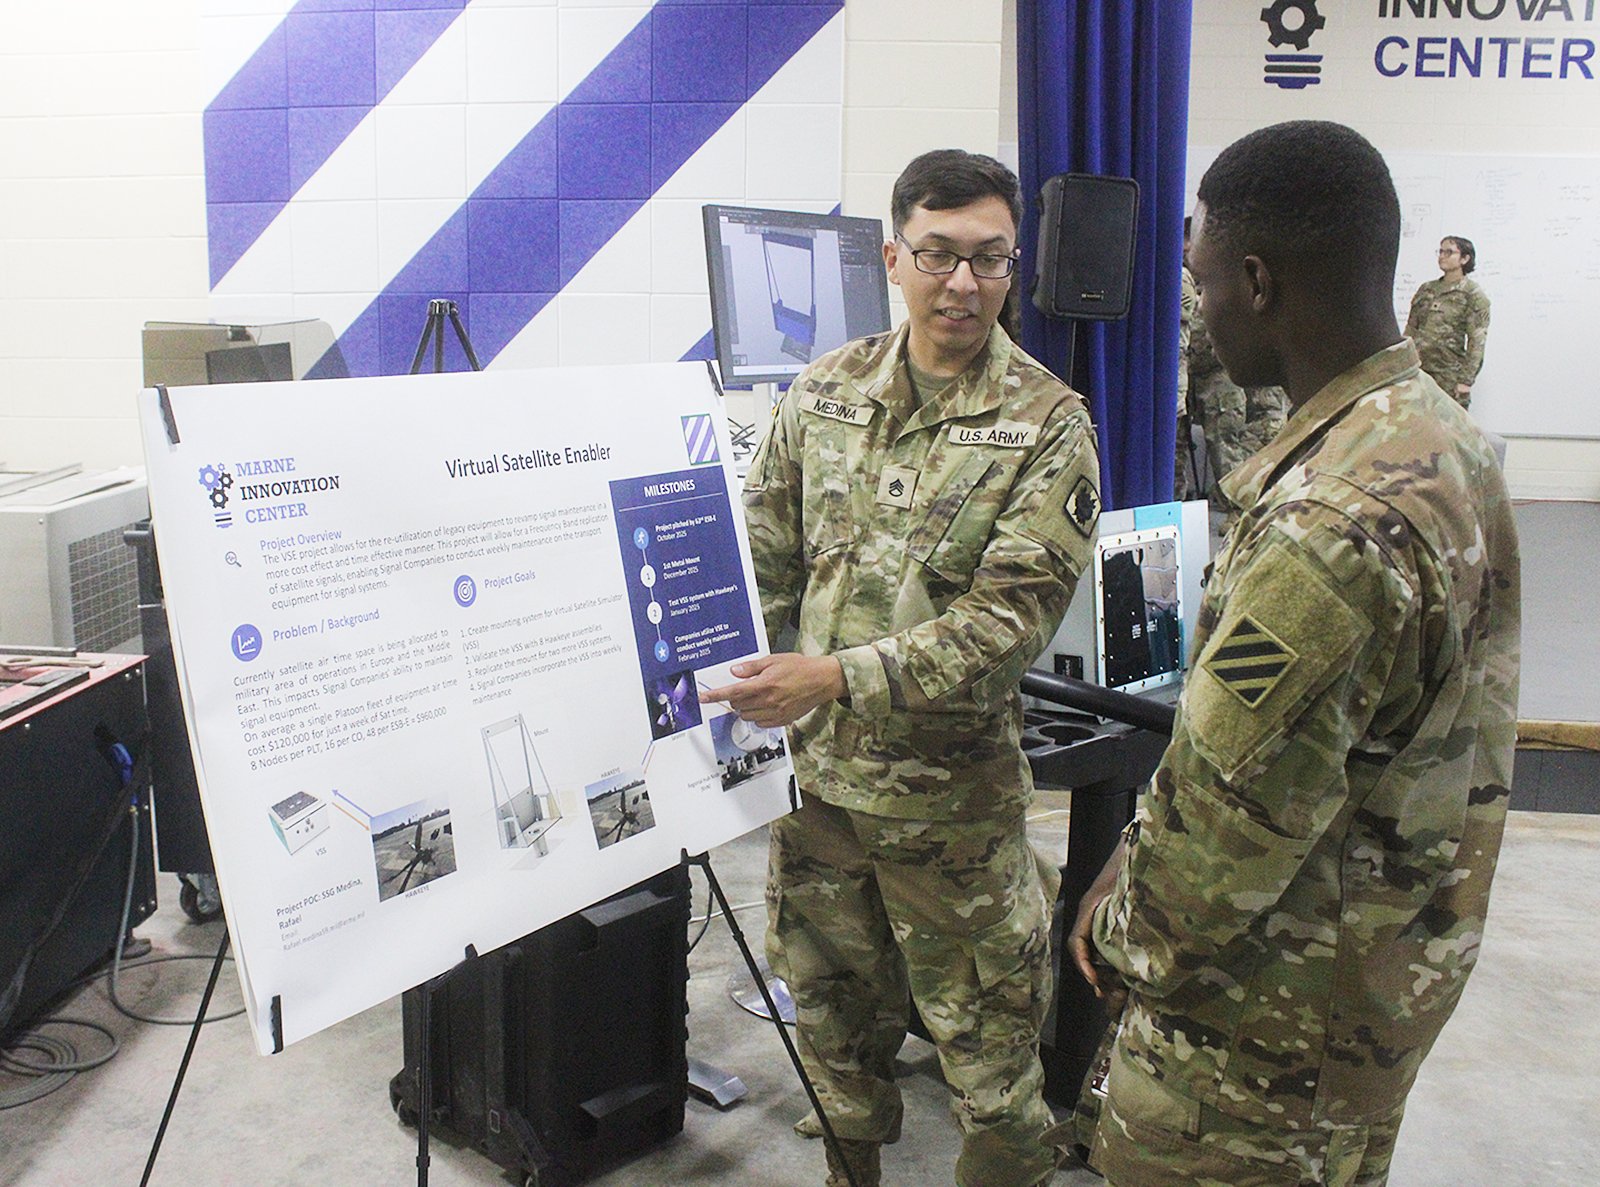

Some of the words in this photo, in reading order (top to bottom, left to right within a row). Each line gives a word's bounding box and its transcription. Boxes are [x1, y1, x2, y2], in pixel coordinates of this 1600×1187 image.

[1374, 35, 1596, 79] CENTER
[813, 398, 857, 421] MEDINA
[959, 429, 983, 442] U.S.
[987, 429, 1029, 446] ARMY
[235, 457, 295, 476] MARNE
[445, 454, 499, 478] Virtual
[502, 449, 561, 471] Satellite
[564, 443, 610, 464] Enabler
[240, 475, 339, 500] INNOVATION
[644, 479, 695, 497] MILESTONES
[245, 502, 308, 523] CENTER
[260, 536, 295, 551] Project
[297, 529, 341, 544] Overview
[262, 554, 279, 564] The
[280, 549, 297, 561] VSE
[299, 546, 328, 560] project
[329, 542, 354, 554] allows
[355, 539, 366, 549] for
[368, 537, 381, 547] the
[383, 529, 432, 544] re-utilization
[442, 525, 465, 536] legacy
[467, 518, 504, 532] equipment
[538, 508, 557, 521] signal
[557, 504, 596, 516] maintenance
[266, 568, 289, 579] more
[291, 564, 308, 575] cost
[310, 560, 333, 572] effect
[334, 556, 350, 567] and
[350, 554, 368, 564] time
[370, 548, 402, 561] effective
[404, 543, 435, 555] manner.
[437, 539, 452, 549] This
[453, 535, 479, 548] project
[479, 532, 492, 542] will
[494, 530, 512, 540] allow
[513, 527, 523, 536] for
[529, 522, 561, 533] Frequency
[562, 518, 578, 528] Band
[268, 583, 278, 595] of
[280, 578, 314, 592] satellite
[346, 567, 379, 580] enabling
[379, 561, 402, 575] Signal
[403, 555, 445, 569] Companies
[455, 548, 484, 560] conduct
[486, 543, 510, 554] weekly
[511, 536, 552, 550] maintenance
[562, 532, 573, 540] the
[484, 575, 512, 588] Project
[514, 569, 535, 582] Goals
[271, 592, 319, 610] equipment
[320, 590, 332, 599] for
[334, 584, 356, 598] signal
[358, 580, 389, 593] systems.
[273, 624, 317, 641] Problem
[327, 608, 379, 629] Background
[233, 669, 274, 686] Currently
[279, 661, 313, 676] satellite
[318, 656, 328, 666] air
[333, 652, 352, 663] time
[355, 647, 375, 659] space
[386, 639, 406, 650] being
[408, 630, 438, 645] allocated
[235, 686, 269, 700] military
[274, 680, 294, 691] area
[298, 674, 307, 685] of
[312, 665, 356, 682] operations
[370, 656, 394, 668] Europe
[397, 650, 410, 661] and
[412, 647, 424, 657] the
[427, 640, 450, 652] Middle
[237, 703, 259, 714] East.
[262, 696, 281, 708] This
[284, 688, 319, 703] impacts
[322, 679, 347, 694] Signal
[392, 664, 412, 676] ability
[240, 713, 267, 729] signal
[269, 702, 320, 721] equipment.
[243, 732, 258, 742] On
[261, 723, 295, 738] average
[307, 712, 332, 726] single
[335, 705, 364, 718] Platoon
[366, 699, 383, 710] fleet
[394, 685, 430, 702] equipment
[432, 682, 440, 691] air
[442, 678, 457, 688] time
[247, 744, 266, 756] cost
[268, 731, 310, 751] $120,000
[311, 729, 323, 739] for
[325, 724, 341, 738] just
[349, 716, 369, 728] week
[379, 710, 390, 720] Sat
[258, 754, 288, 768] Nodes
[290, 749, 304, 761] per
[324, 738, 335, 750] 16
[336, 736, 349, 747] per
[377, 725, 388, 736] per
[276, 901, 303, 916] Project
[303, 893, 320, 906] POC:
[321, 887, 335, 899] SSG
[278, 914, 302, 929] Rafael
